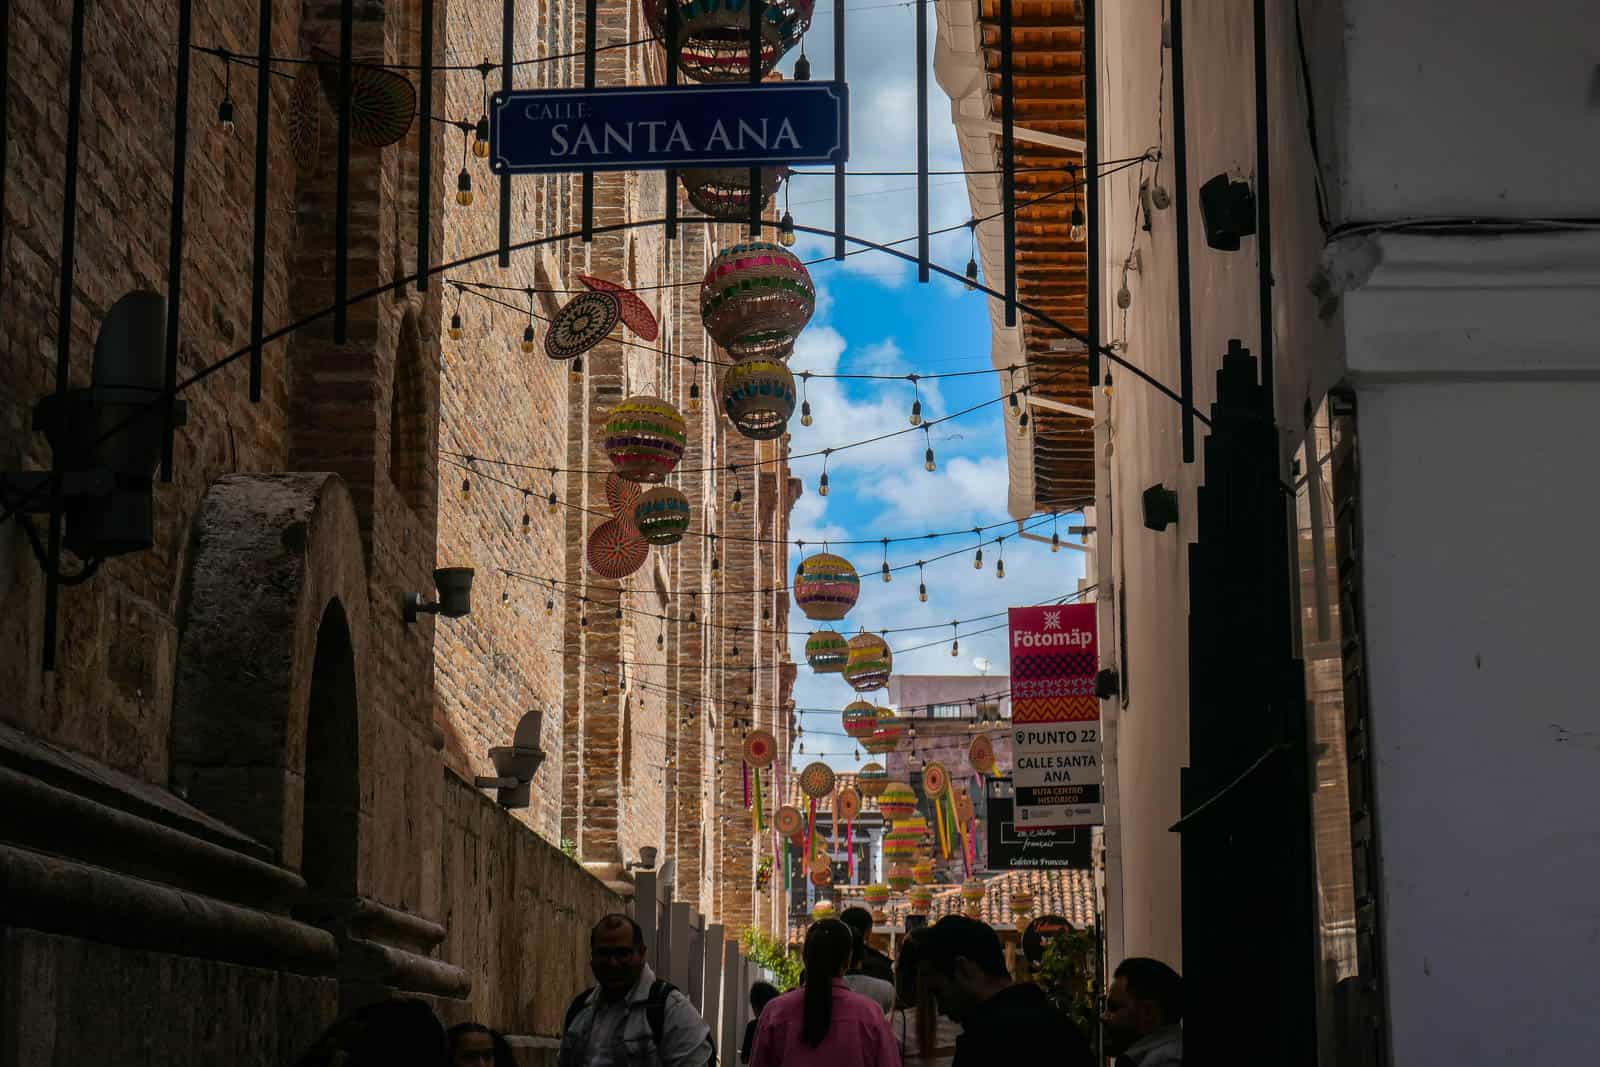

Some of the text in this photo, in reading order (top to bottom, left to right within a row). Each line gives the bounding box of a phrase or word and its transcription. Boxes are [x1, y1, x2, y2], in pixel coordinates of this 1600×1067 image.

[550, 116, 803, 157] SANTA ANA
[1013, 627, 1093, 648] Fötomäp
[1028, 730, 1096, 744] PUNTO 22
[1017, 755, 1096, 769] CALLE SANTA
[1043, 771, 1071, 782] ANA
[1032, 786, 1084, 797] RUTA CENTRO
